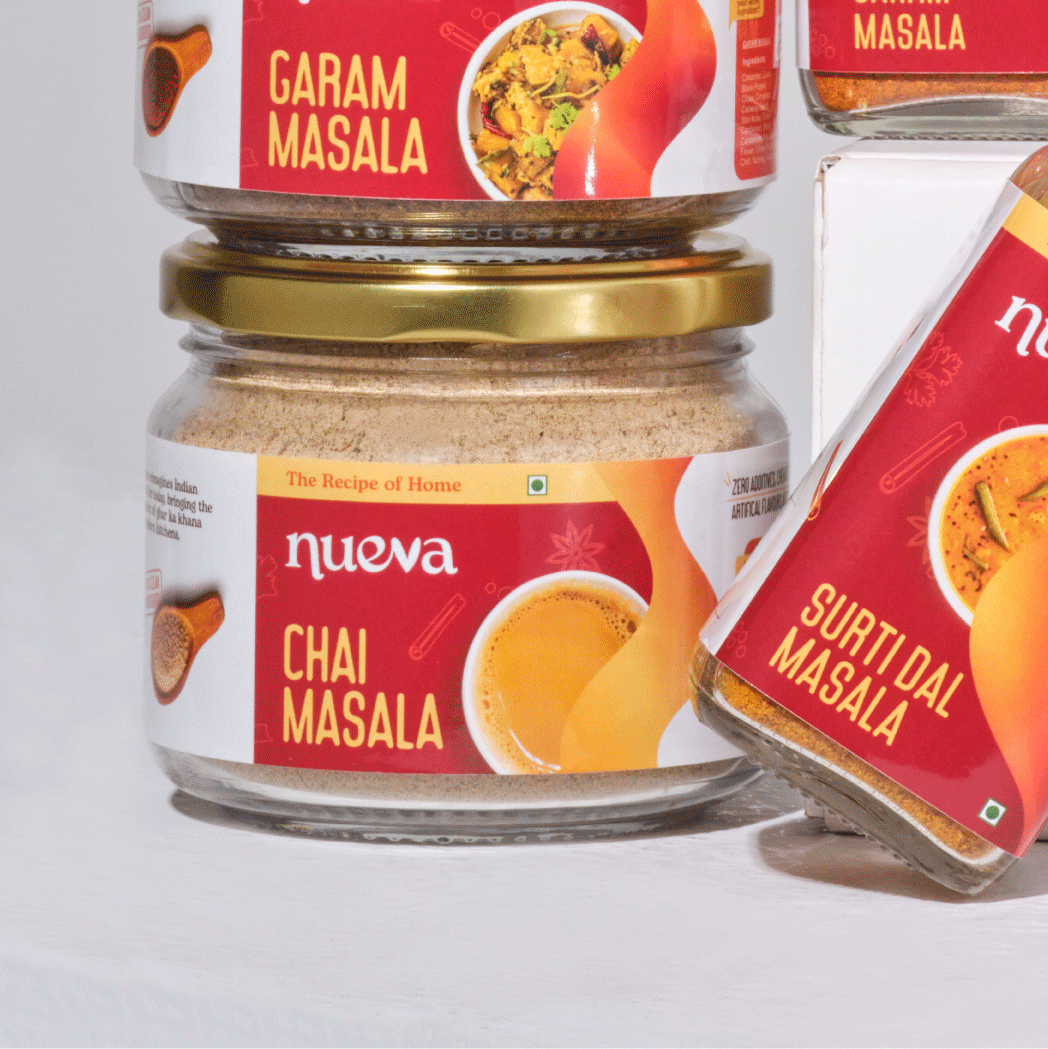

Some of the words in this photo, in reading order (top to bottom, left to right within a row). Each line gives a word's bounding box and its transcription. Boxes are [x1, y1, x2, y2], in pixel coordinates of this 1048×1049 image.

[854, 13, 966, 50] MASALA
[269, 49, 407, 111] GARAM
[268, 111, 428, 174] MASALA
[167, 492, 196, 514] bringing
[198, 500, 213, 513] the
[174, 477, 198, 495] Indian
[286, 470, 317, 488] The
[321, 473, 379, 495] Recipe
[384, 475, 402, 492] of
[408, 477, 463, 493] Home
[731, 476, 750, 495] ZERO
[177, 512, 202, 528] khana
[285, 532, 458, 581] nueva
[284, 623, 367, 685] CHAI
[800, 583, 906, 675] SURTI
[893, 645, 964, 718] DAL
[768, 625, 909, 746] MASALA
[283, 686, 444, 750] MASALA
